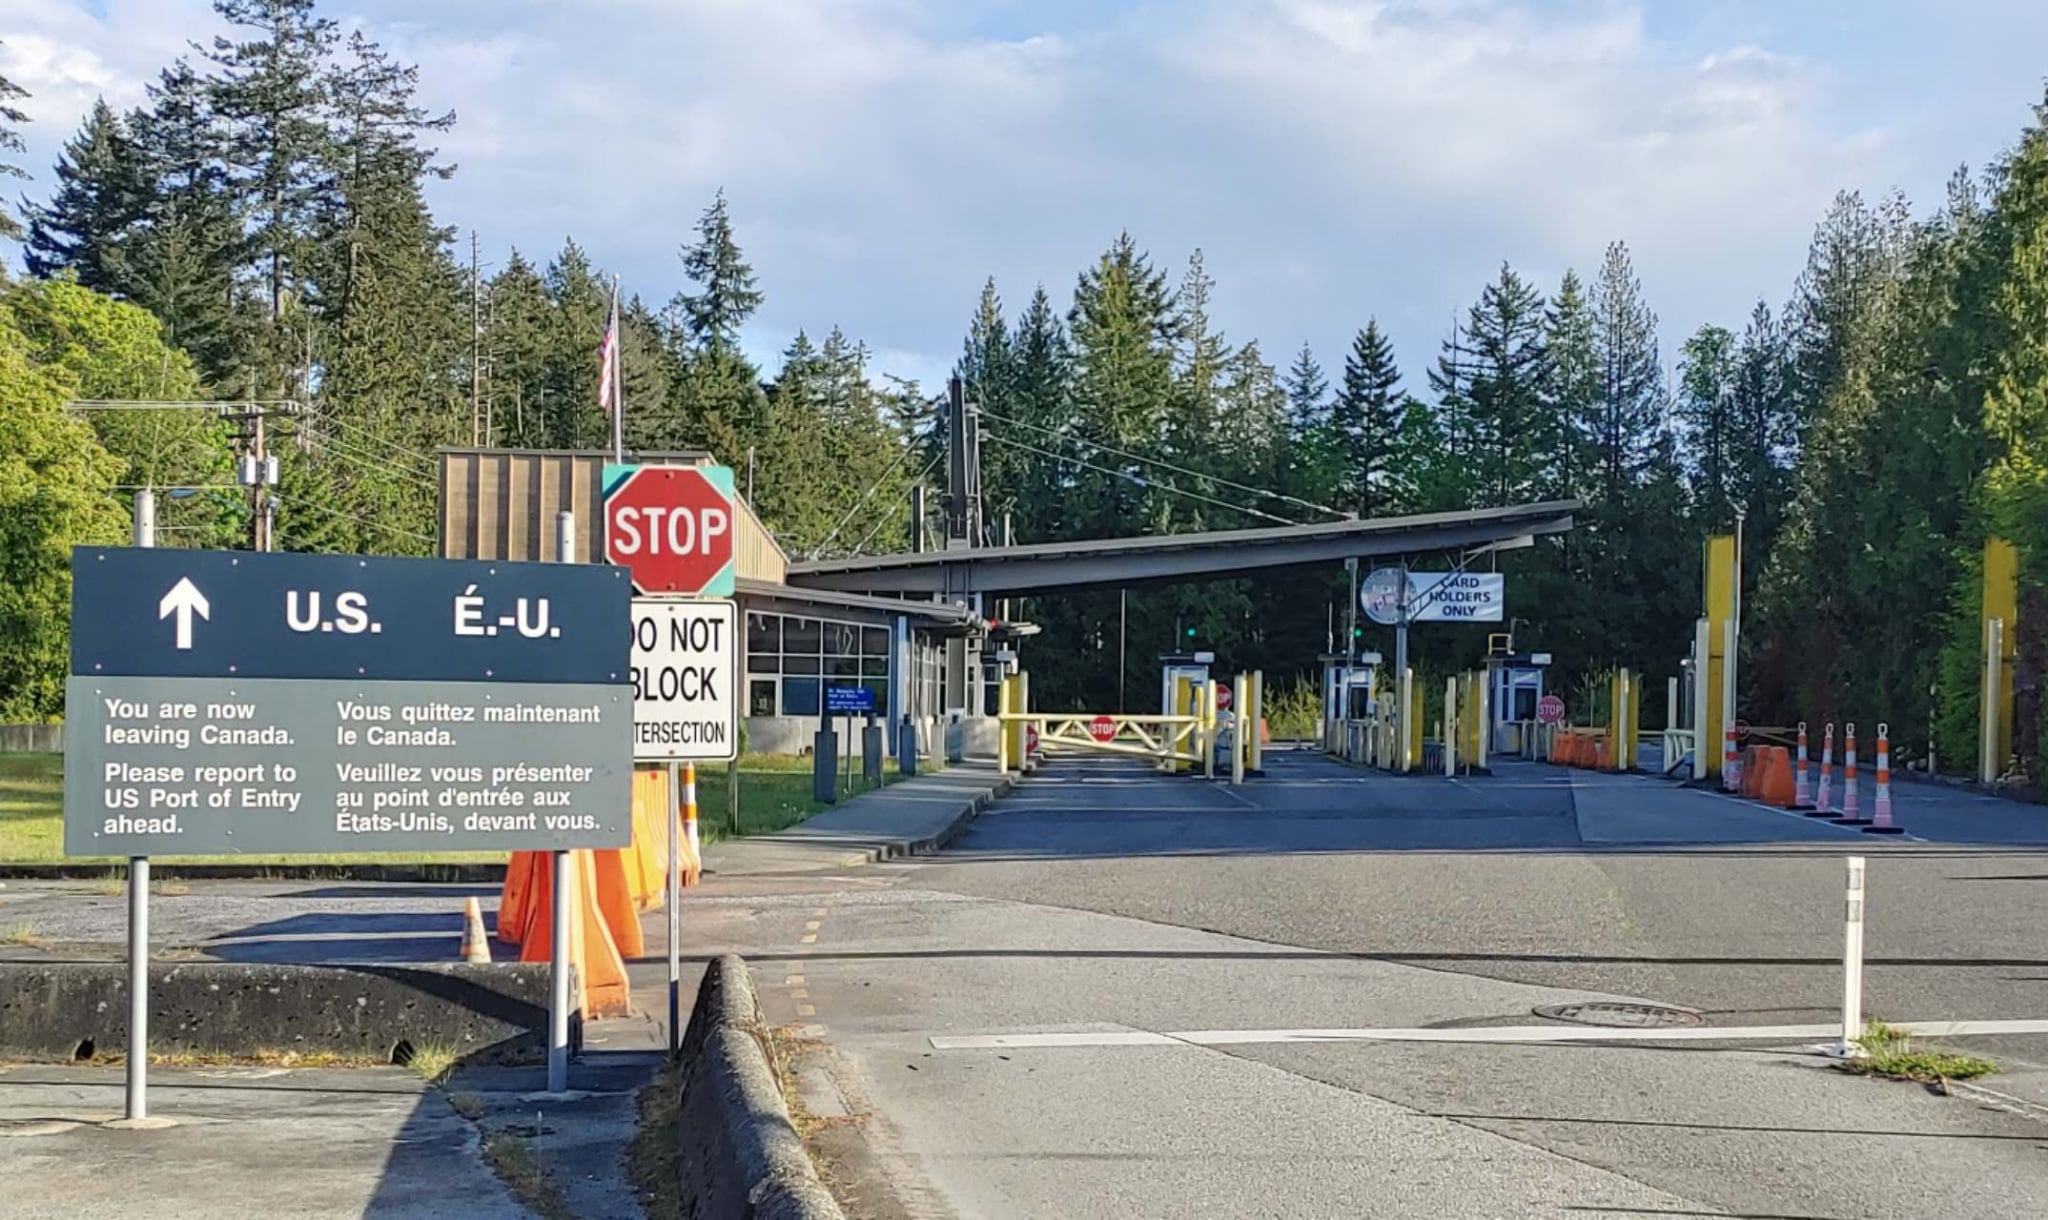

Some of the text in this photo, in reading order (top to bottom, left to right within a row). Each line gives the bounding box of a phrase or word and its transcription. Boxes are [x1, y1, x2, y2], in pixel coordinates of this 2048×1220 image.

[614, 506, 728, 555] STOP
[1429, 591, 1491, 602] HOLDERS
[286, 591, 382, 633] U.S.
[453, 584, 561, 638] É.-U.
[1442, 605, 1477, 616] ONLY
[631, 616, 724, 652] O NOT
[104, 698, 256, 719] You are now
[336, 701, 601, 725] Vous quittez maintenant
[1539, 705, 1562, 715] STOP
[105, 724, 295, 749] leaving Canada.
[337, 726, 457, 746] le Canada.
[634, 721, 725, 743] TERSECTION
[1092, 723, 1115, 735] STOP
[105, 762, 297, 787] Please report to
[336, 762, 593, 787] Veuillez vous présenter
[105, 788, 302, 812] US Port of Entry
[336, 786, 571, 811] au point d'entrée aux
[104, 814, 183, 834] ahead.
[336, 808, 601, 834] États-Unis, devant vous.
